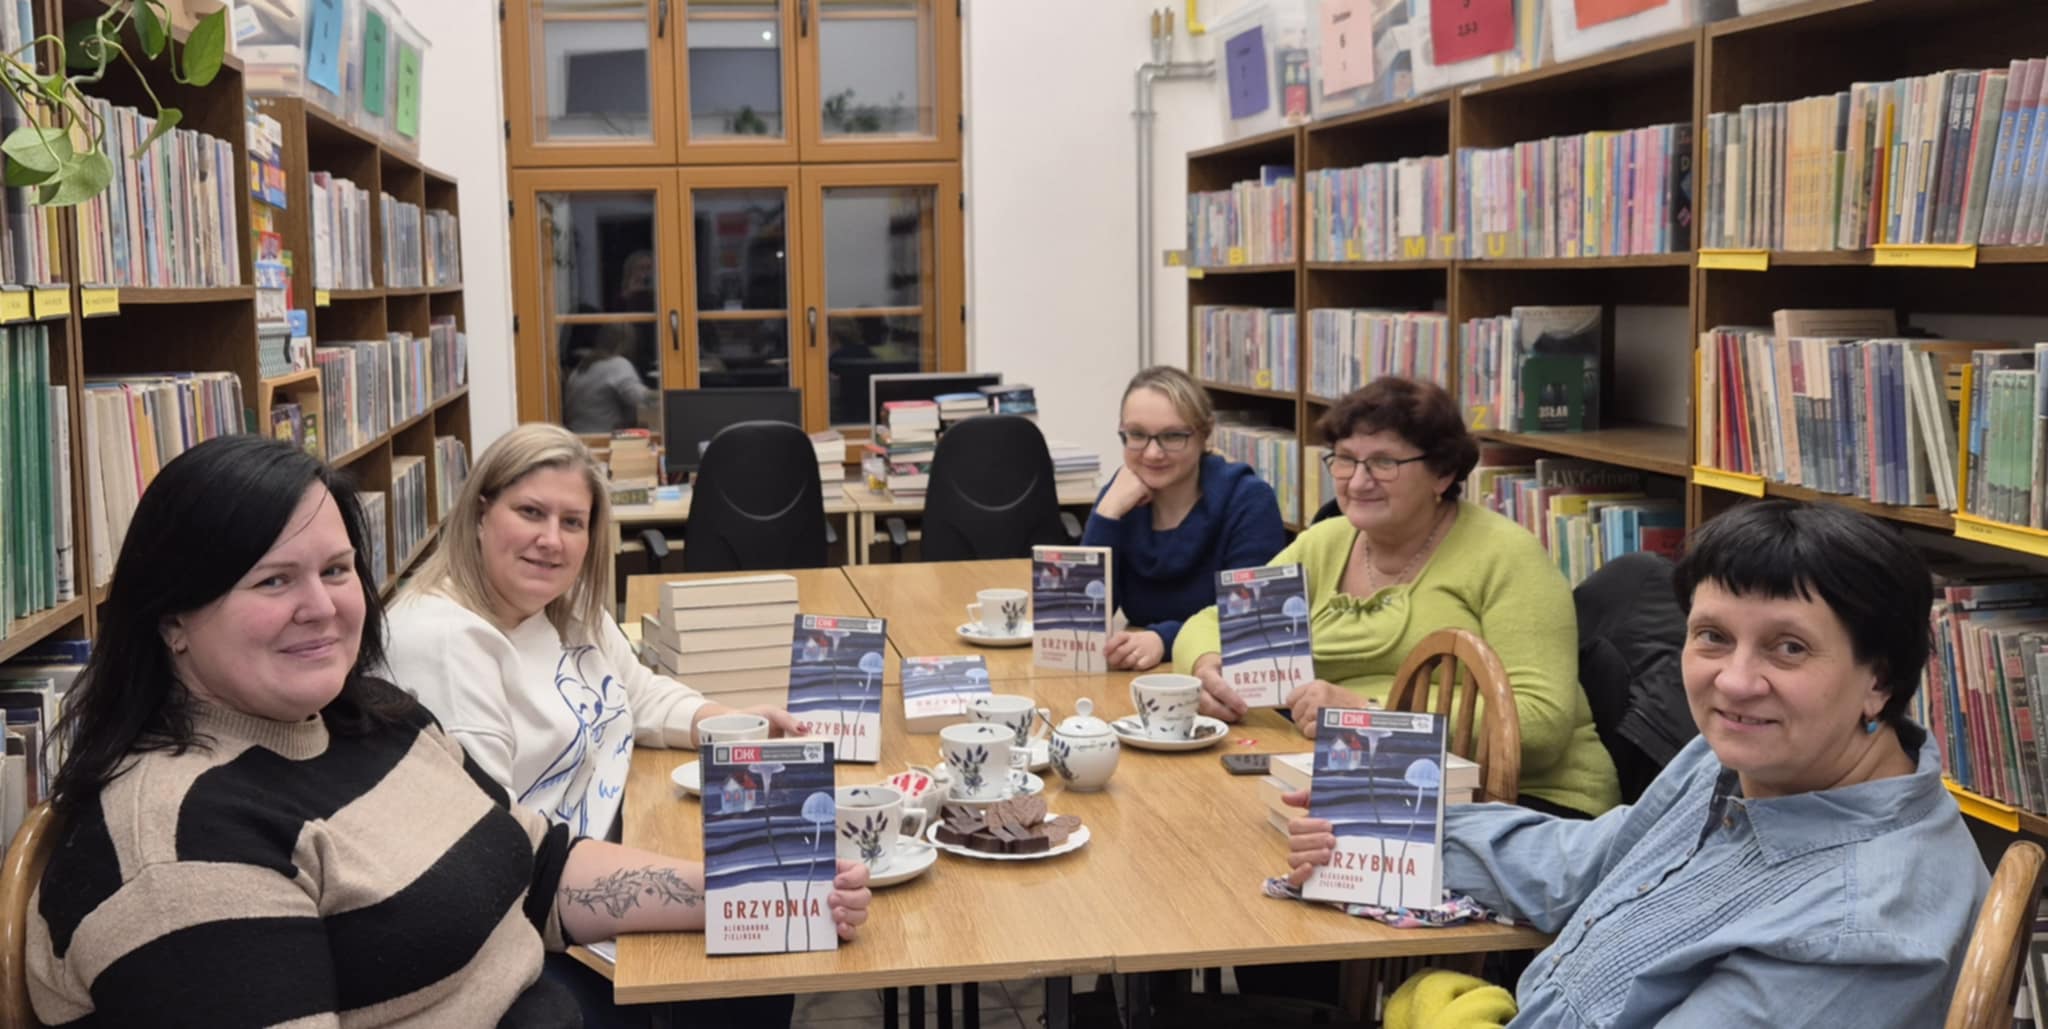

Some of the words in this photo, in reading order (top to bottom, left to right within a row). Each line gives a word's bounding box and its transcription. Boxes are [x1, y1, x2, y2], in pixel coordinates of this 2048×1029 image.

[1346, 239, 1361, 259] L
[1404, 236, 1426, 257] M
[1439, 236, 1455, 257] T
[1488, 234, 1505, 257] U
[1168, 252, 1180, 266] A
[1256, 370, 1272, 388] C
[1471, 405, 1488, 430] Z
[1041, 637, 1096, 652] GRZYBNIA
[1234, 668, 1302, 685] GRZYBNIA
[1326, 851, 1416, 876] RZYBNIA
[723, 898, 820, 919] GRZYBNIA
